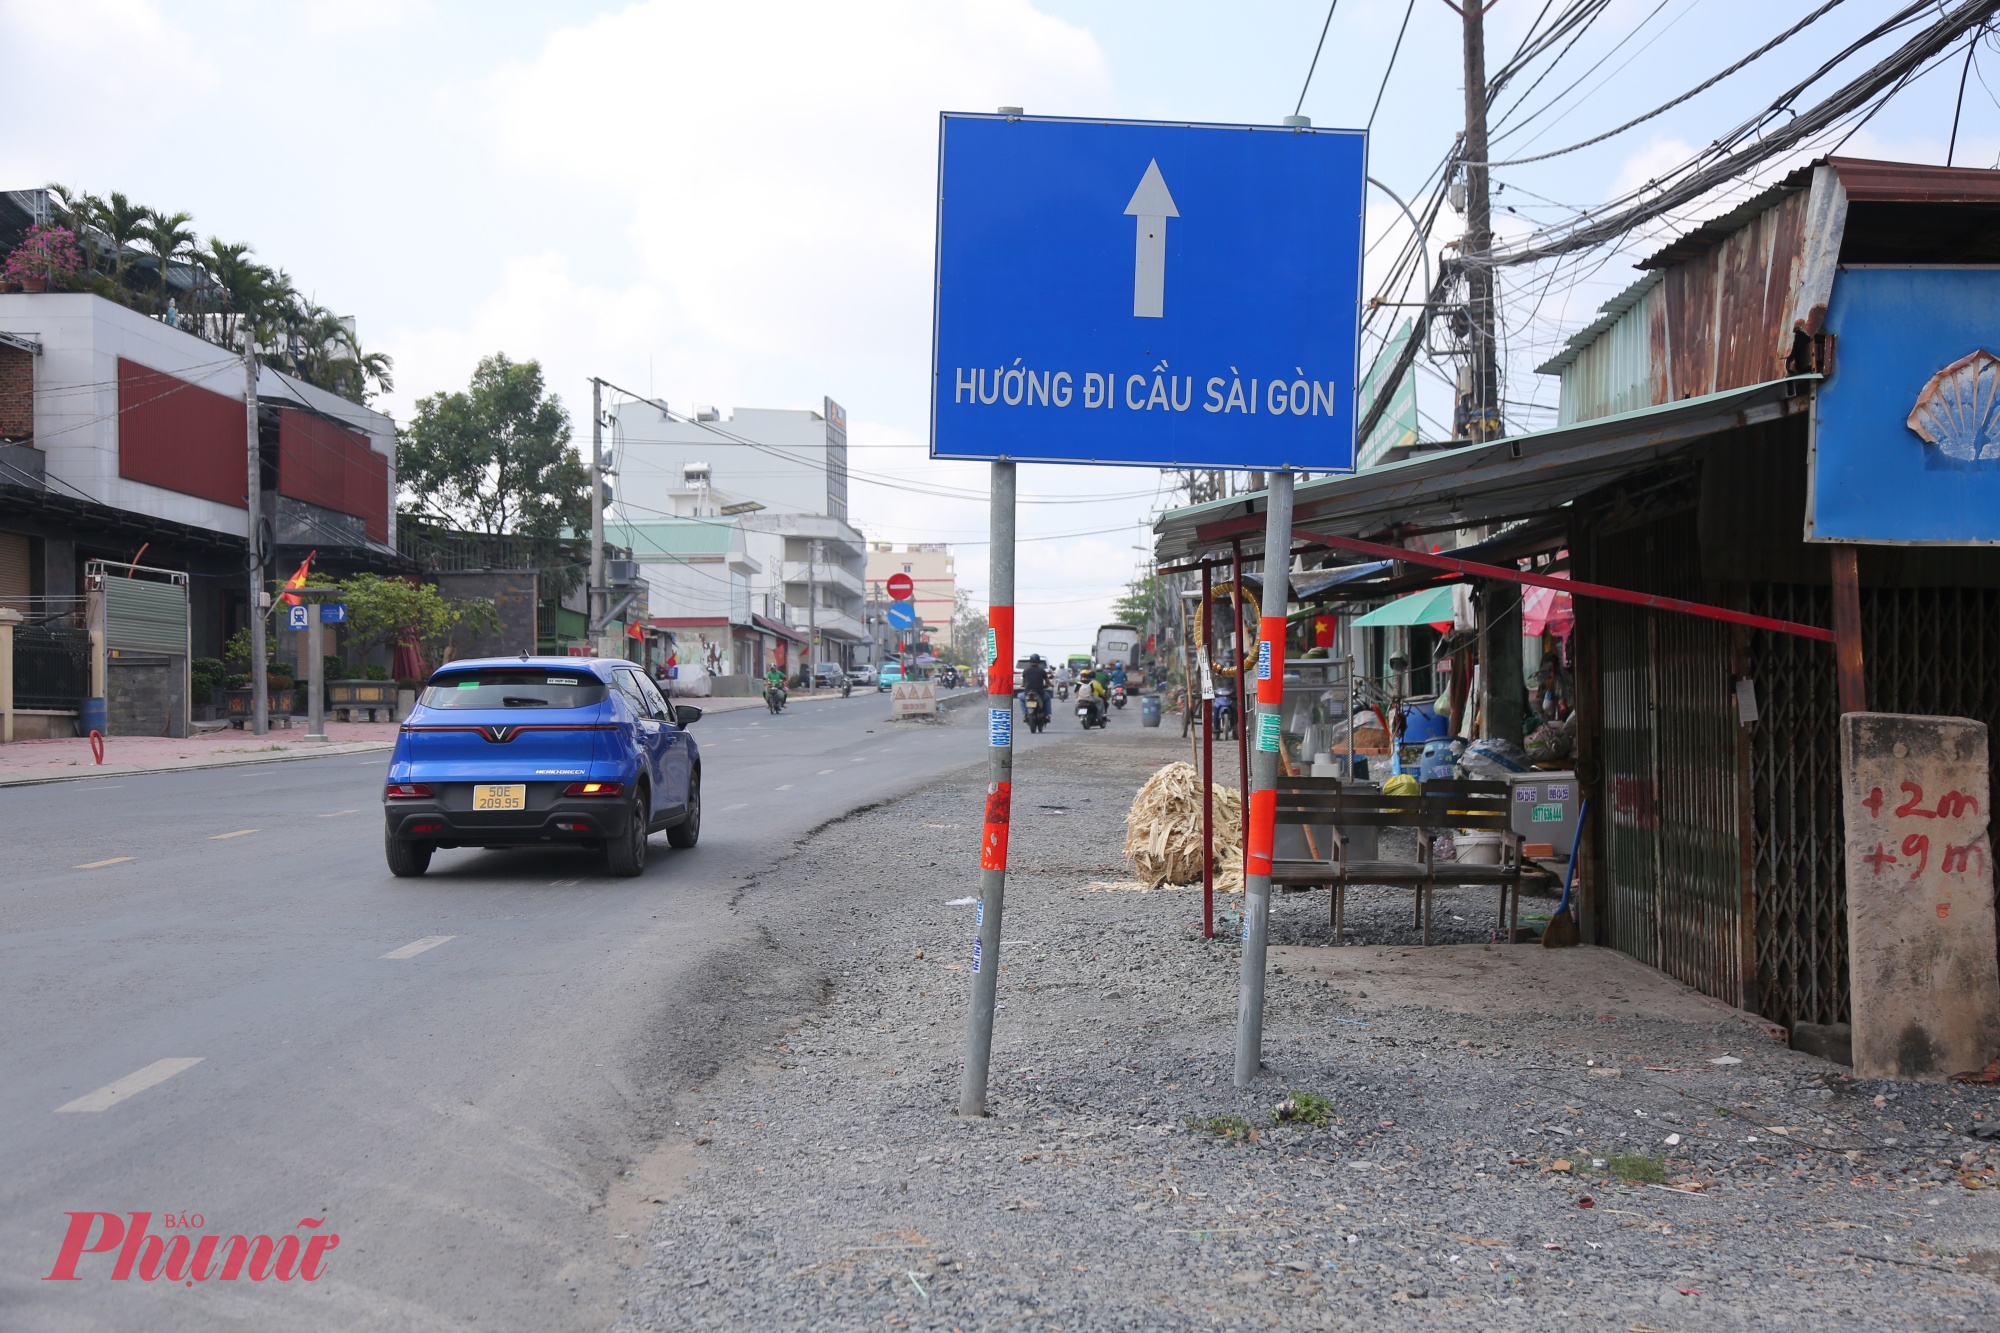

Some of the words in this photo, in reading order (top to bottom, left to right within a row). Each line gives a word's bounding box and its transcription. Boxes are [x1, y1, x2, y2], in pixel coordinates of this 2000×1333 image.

[955, 357, 1073, 408] HƯỚNG
[1083, 372, 1115, 409] ĐI
[1125, 359, 1192, 412] CẦU
[1202, 366, 1258, 414] SÀI
[1267, 366, 1335, 417] GÒN
[489, 786, 511, 797] 50E
[480, 797, 519, 809] 209.95
